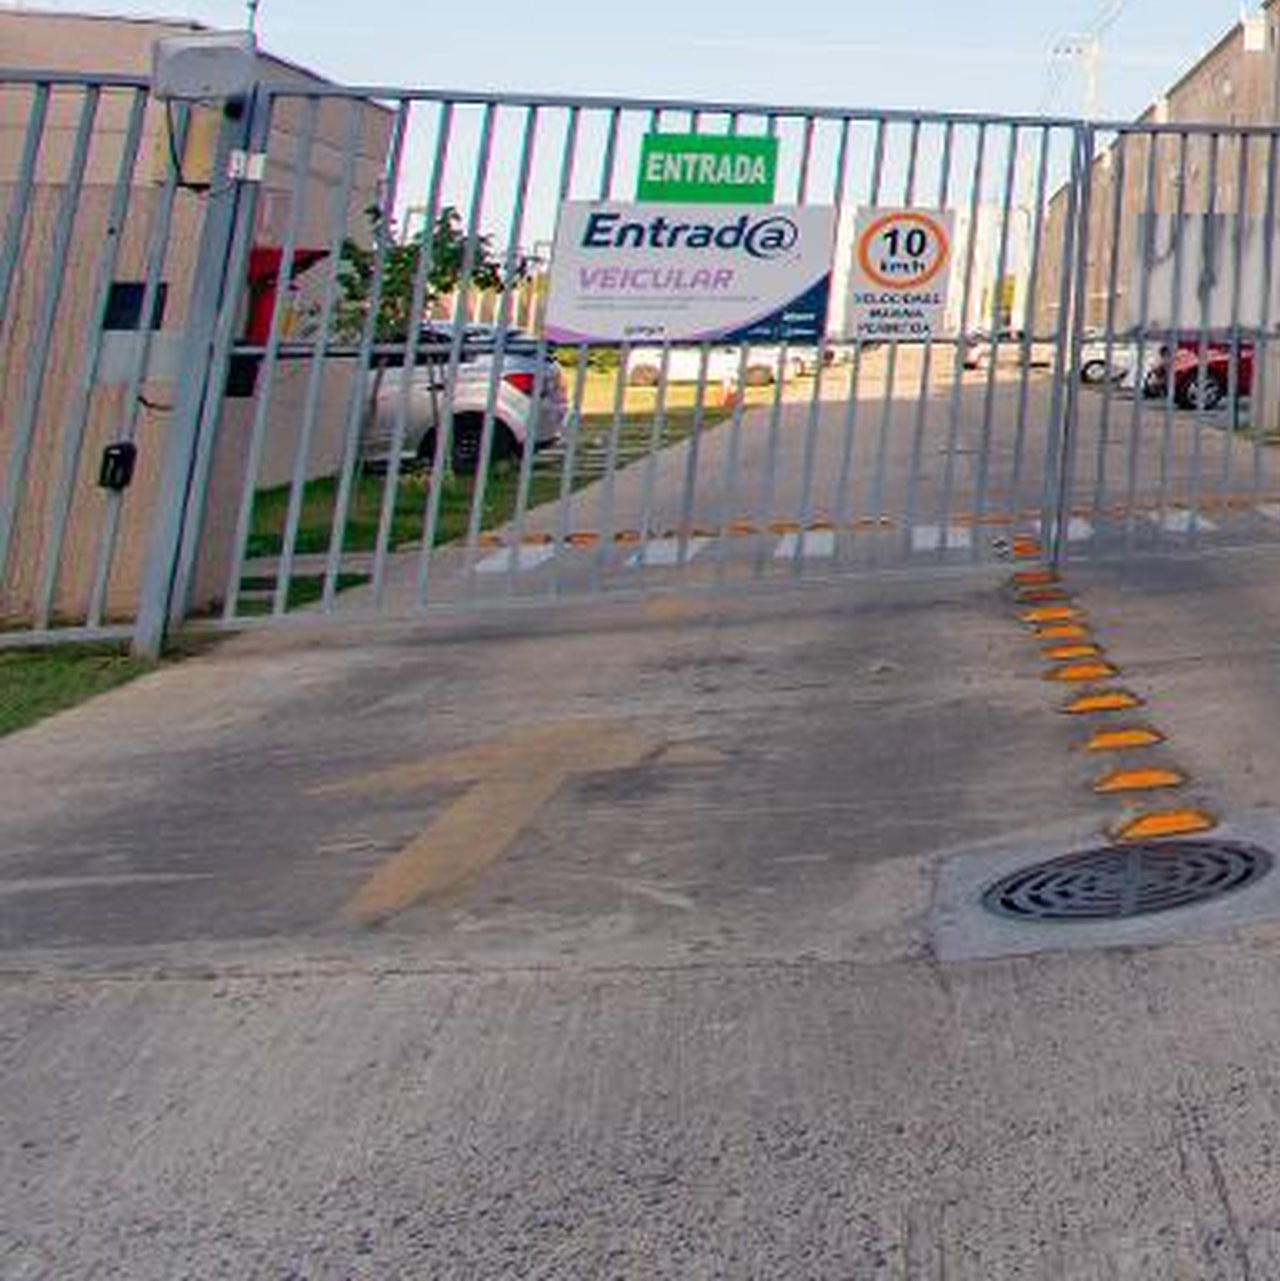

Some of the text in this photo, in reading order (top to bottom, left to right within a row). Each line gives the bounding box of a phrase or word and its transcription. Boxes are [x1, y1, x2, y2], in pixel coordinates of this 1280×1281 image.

[645, 151, 768, 185] ENTRADA
[581, 212, 799, 259] Entrad@
[882, 228, 927, 258] 10
[578, 267, 735, 290] VEICULAR
